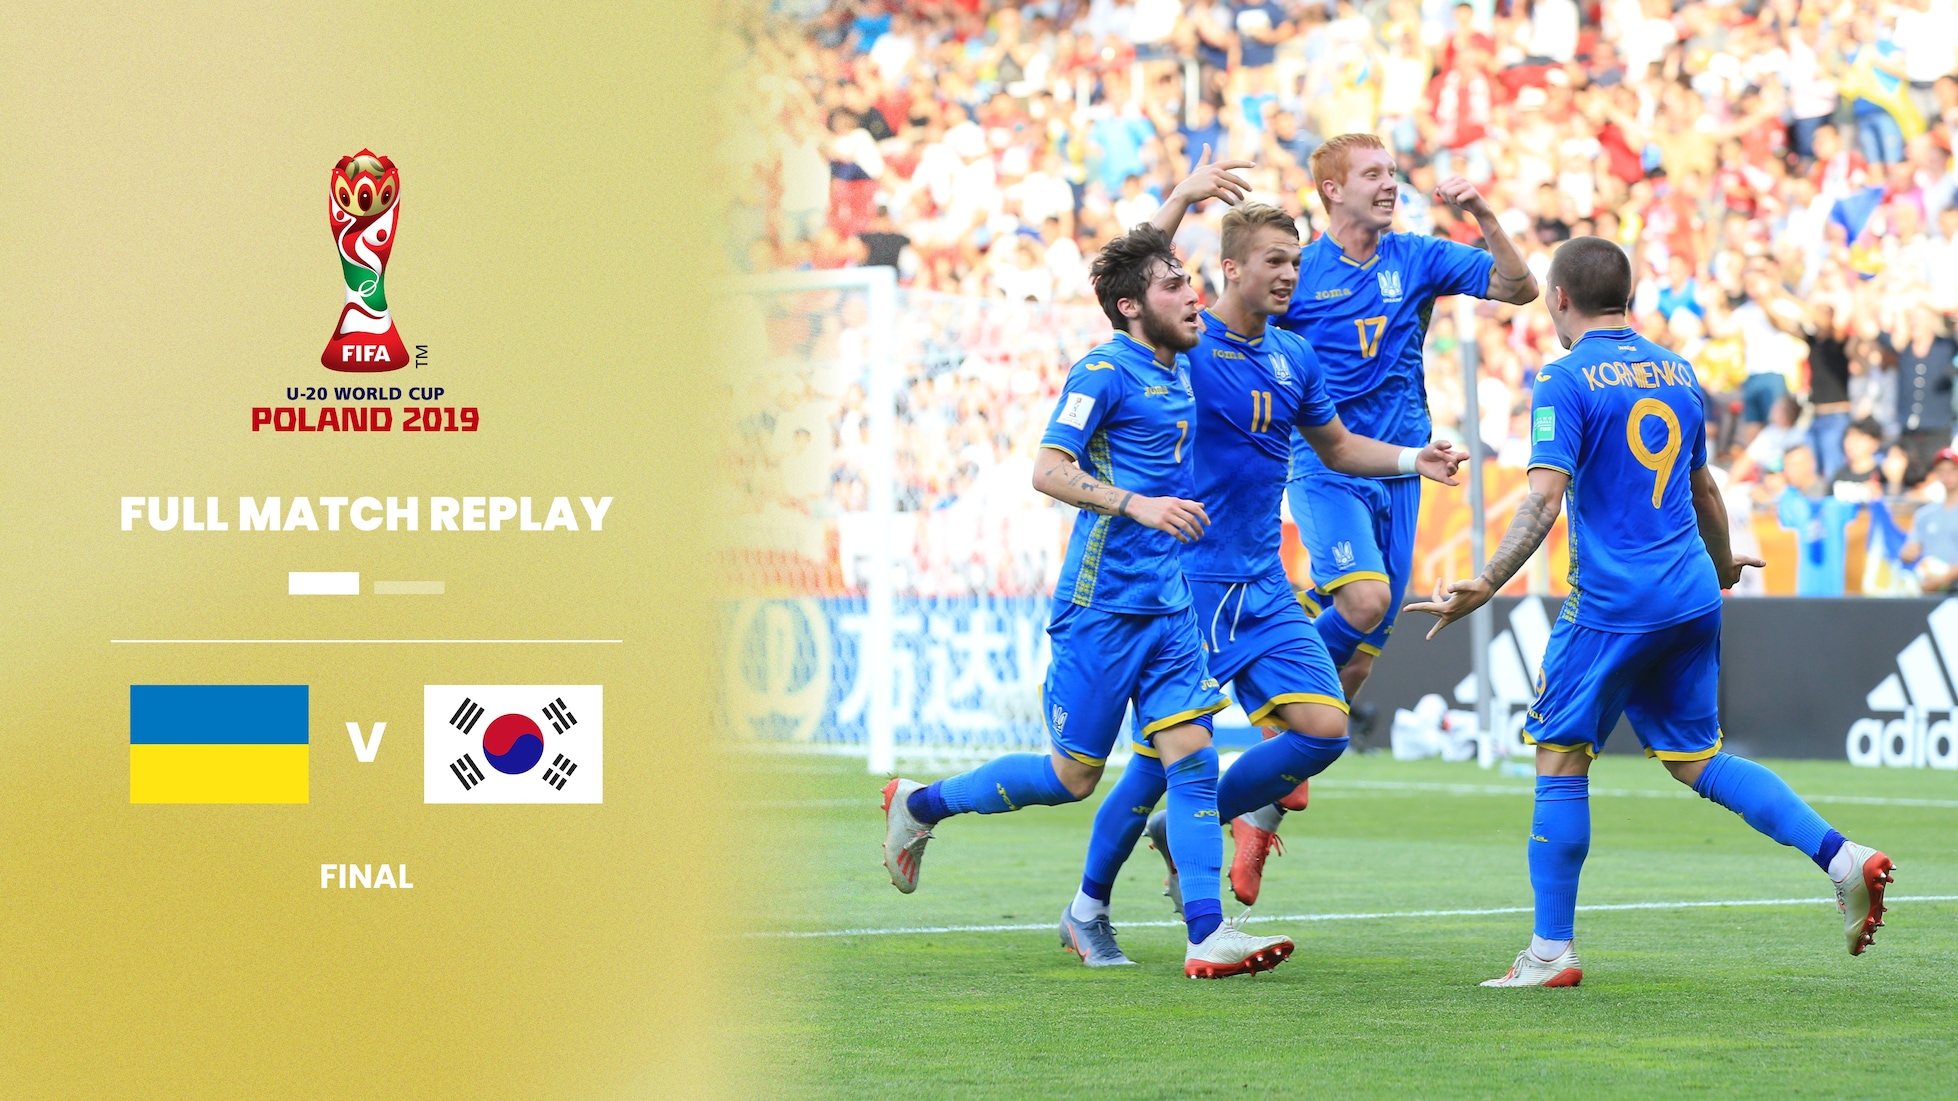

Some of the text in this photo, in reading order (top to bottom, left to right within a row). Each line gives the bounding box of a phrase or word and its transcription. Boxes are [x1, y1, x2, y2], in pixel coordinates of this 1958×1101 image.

[1354, 315, 1387, 358] 17
[1581, 360, 1692, 392] KORNIENKO
[1251, 390, 1272, 433] 11
[1174, 420, 1188, 463] 7
[1626, 398, 1682, 509] 9
